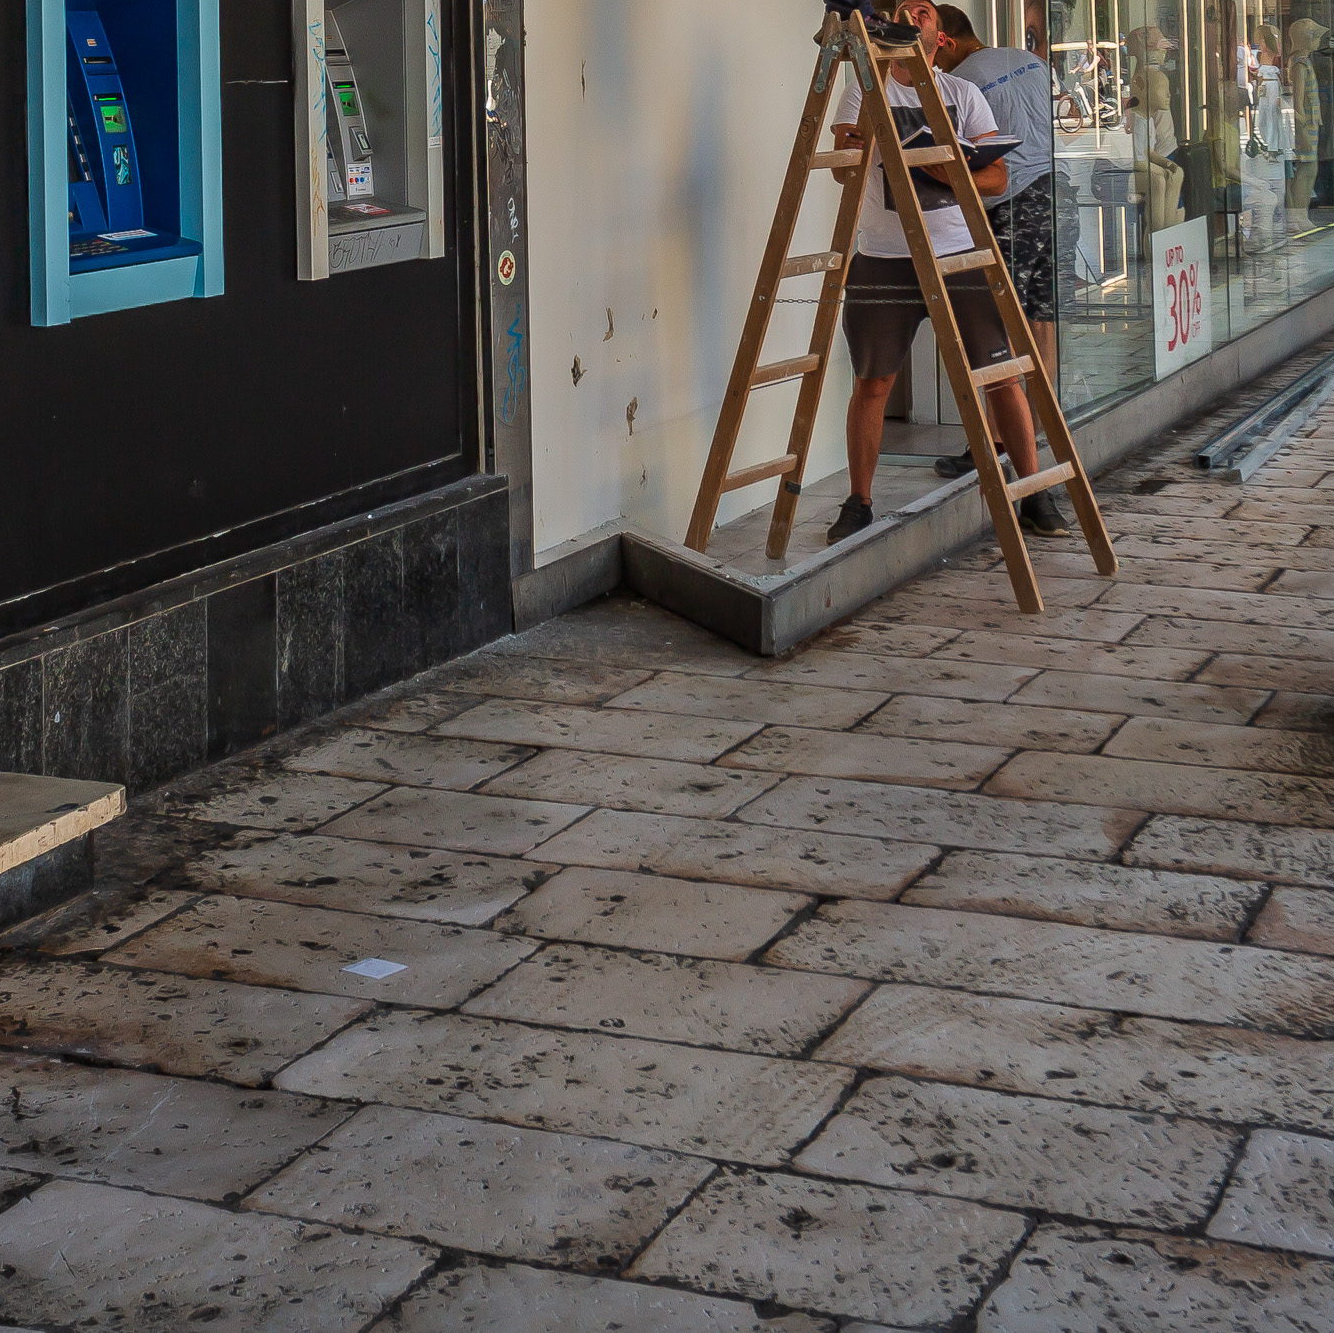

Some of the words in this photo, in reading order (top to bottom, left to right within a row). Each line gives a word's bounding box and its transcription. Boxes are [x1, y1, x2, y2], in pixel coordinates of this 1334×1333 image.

[1165, 248, 1175, 268] UP
[1174, 245, 1185, 265] TO
[1166, 259, 1203, 353] 30%
